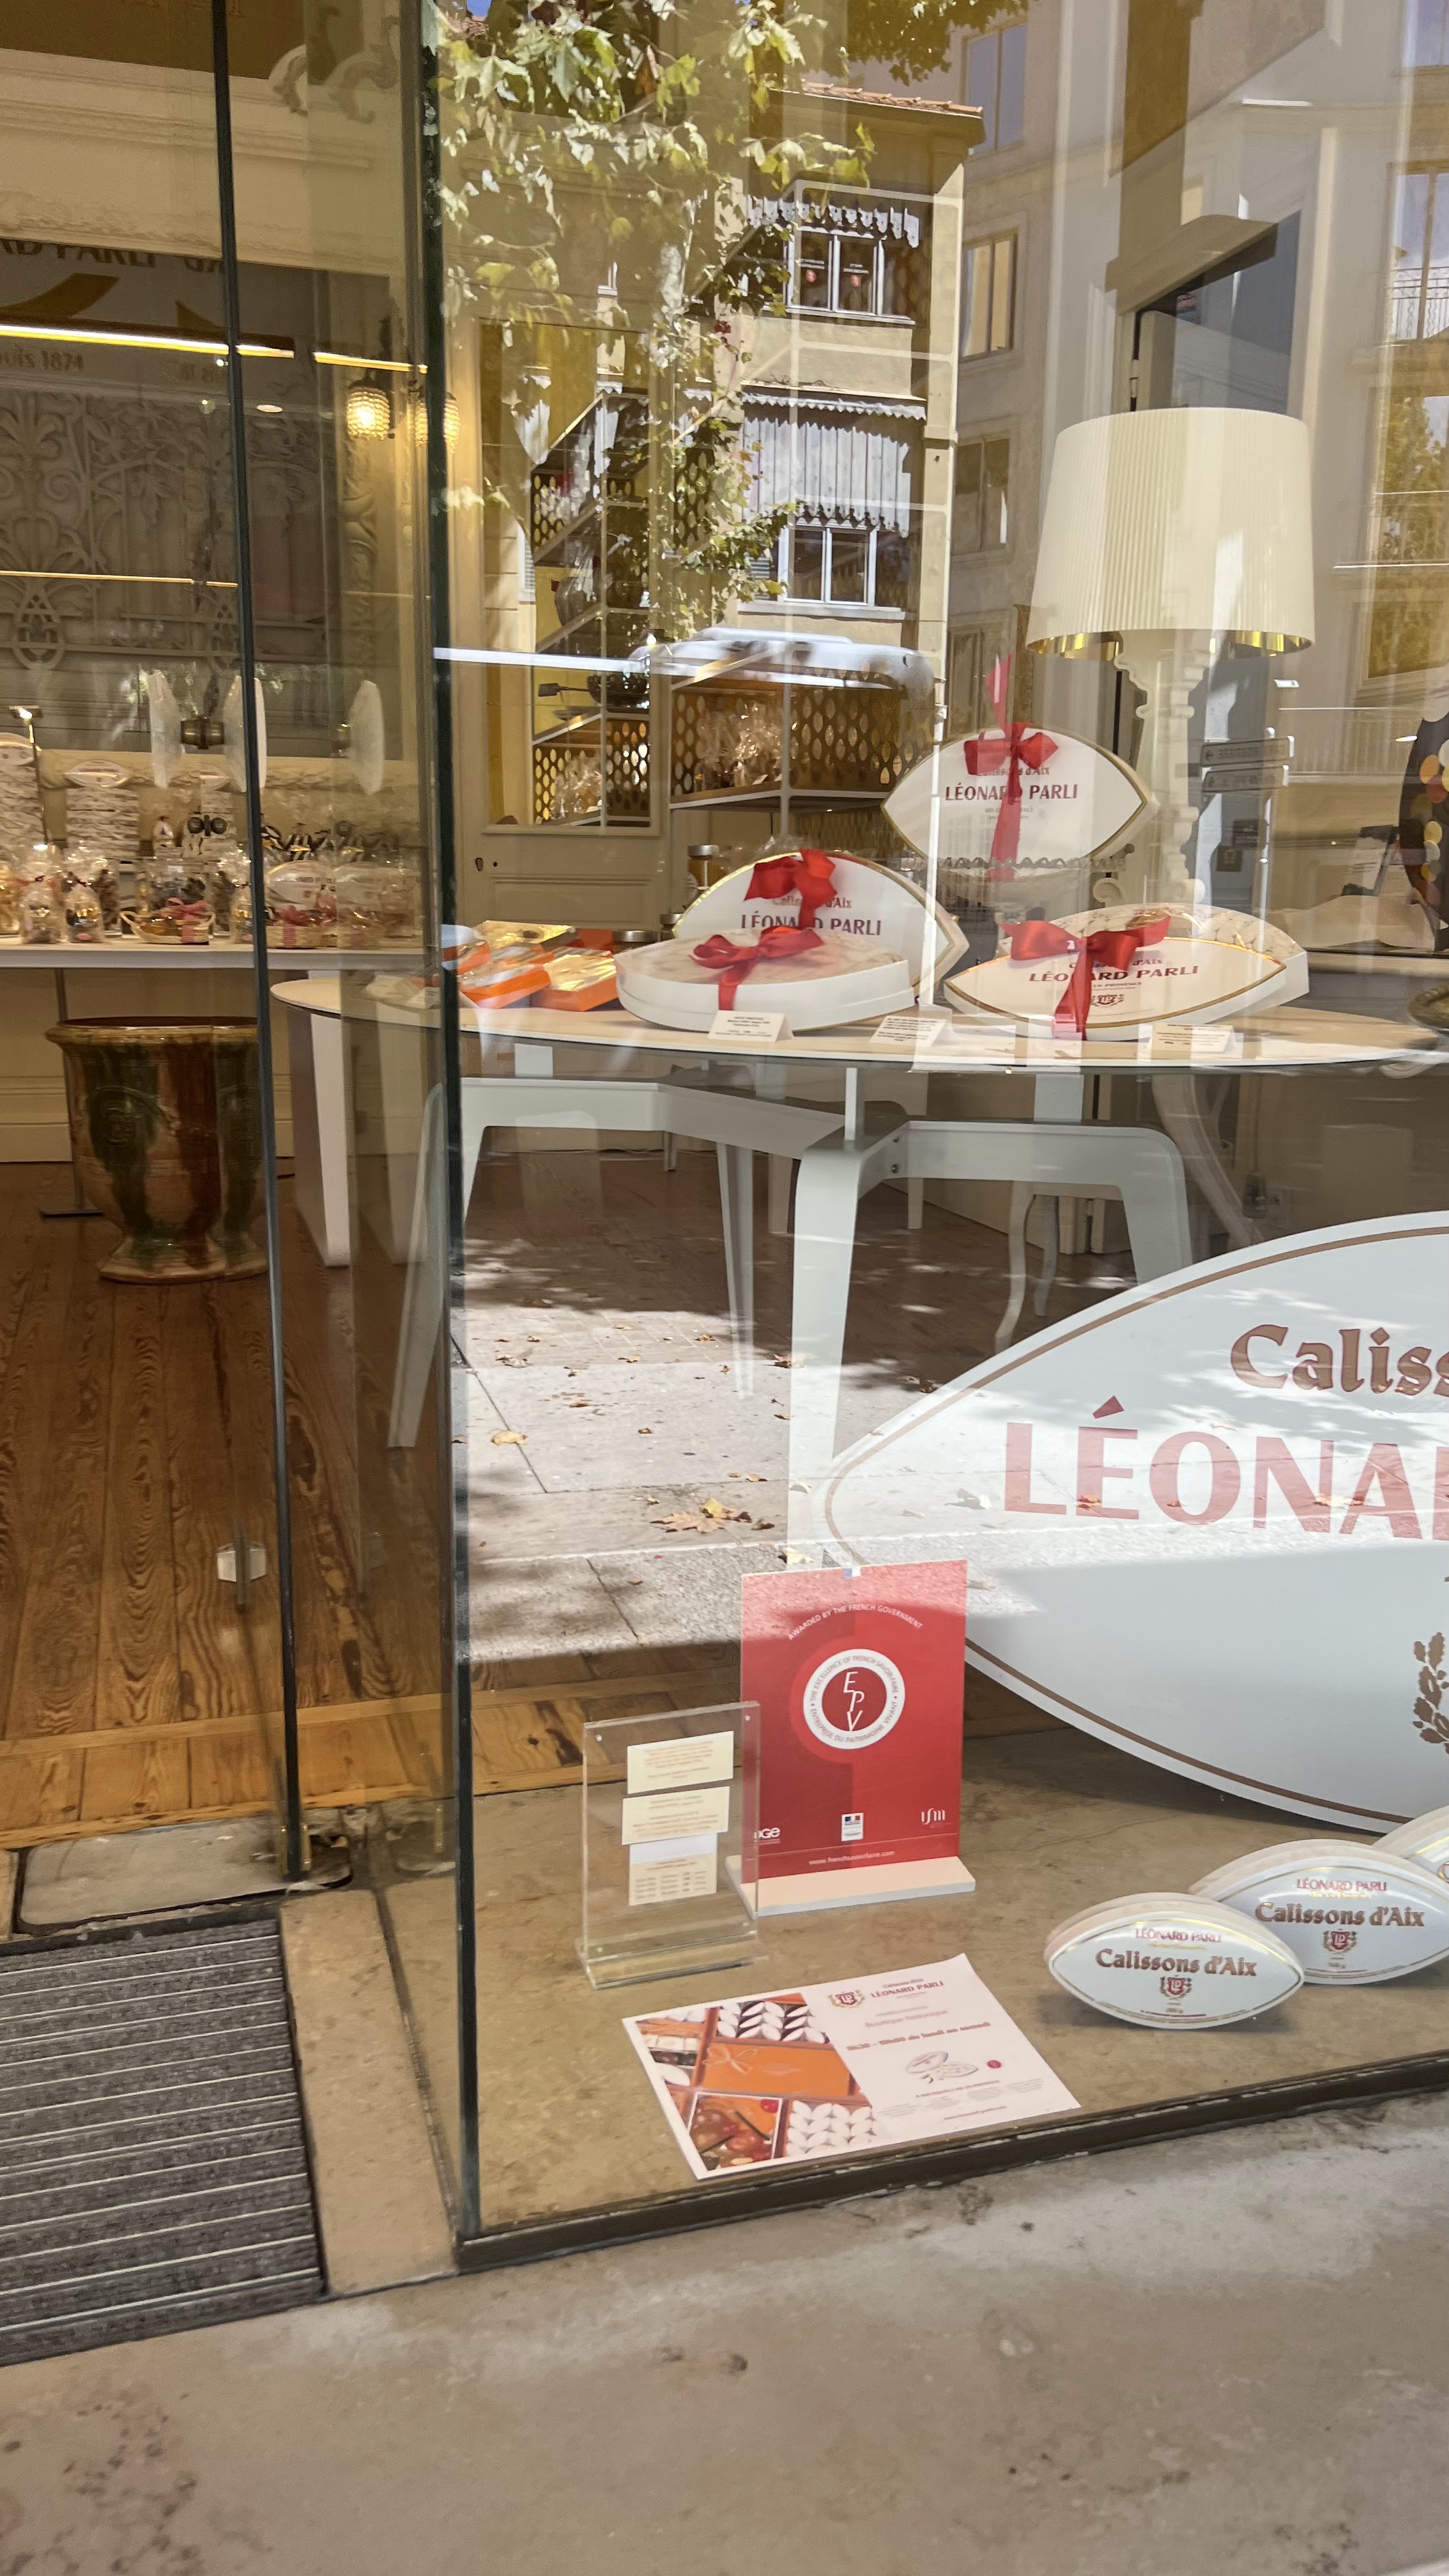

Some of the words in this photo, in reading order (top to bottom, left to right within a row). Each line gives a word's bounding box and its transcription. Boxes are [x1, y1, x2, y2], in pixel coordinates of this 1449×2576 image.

[1025, 766, 1050, 776] dAix
[946, 783, 1022, 801] LÉONAR
[1029, 784, 1078, 799] PARLI
[742, 910, 823, 930] LÉONAD
[831, 917, 881, 936] PARLI
[1029, 970, 1128, 982] LÉORD
[1136, 965, 1199, 979] PARLI
[788, 1614, 822, 1641] AWARDED
[822, 1610, 831, 1618] BY
[832, 1606, 847, 1614] THE
[877, 1605, 923, 1629] GOVERNMENT
[1296, 1877, 1353, 1890] LÉONARD
[1356, 1880, 1387, 1891] PARLI
[1255, 1901, 1365, 1925] Calissons
[1368, 1906, 1425, 1927] d'Aix
[1135, 1928, 1188, 1941] LÉONARD
[1192, 1931, 1222, 1943] PARLI
[1095, 1948, 1200, 1973] Calissons
[1204, 1956, 1257, 1977] d'Aix
[870, 1986, 914, 1998] LÉONARD
[916, 1981, 945, 1990] PARLI
